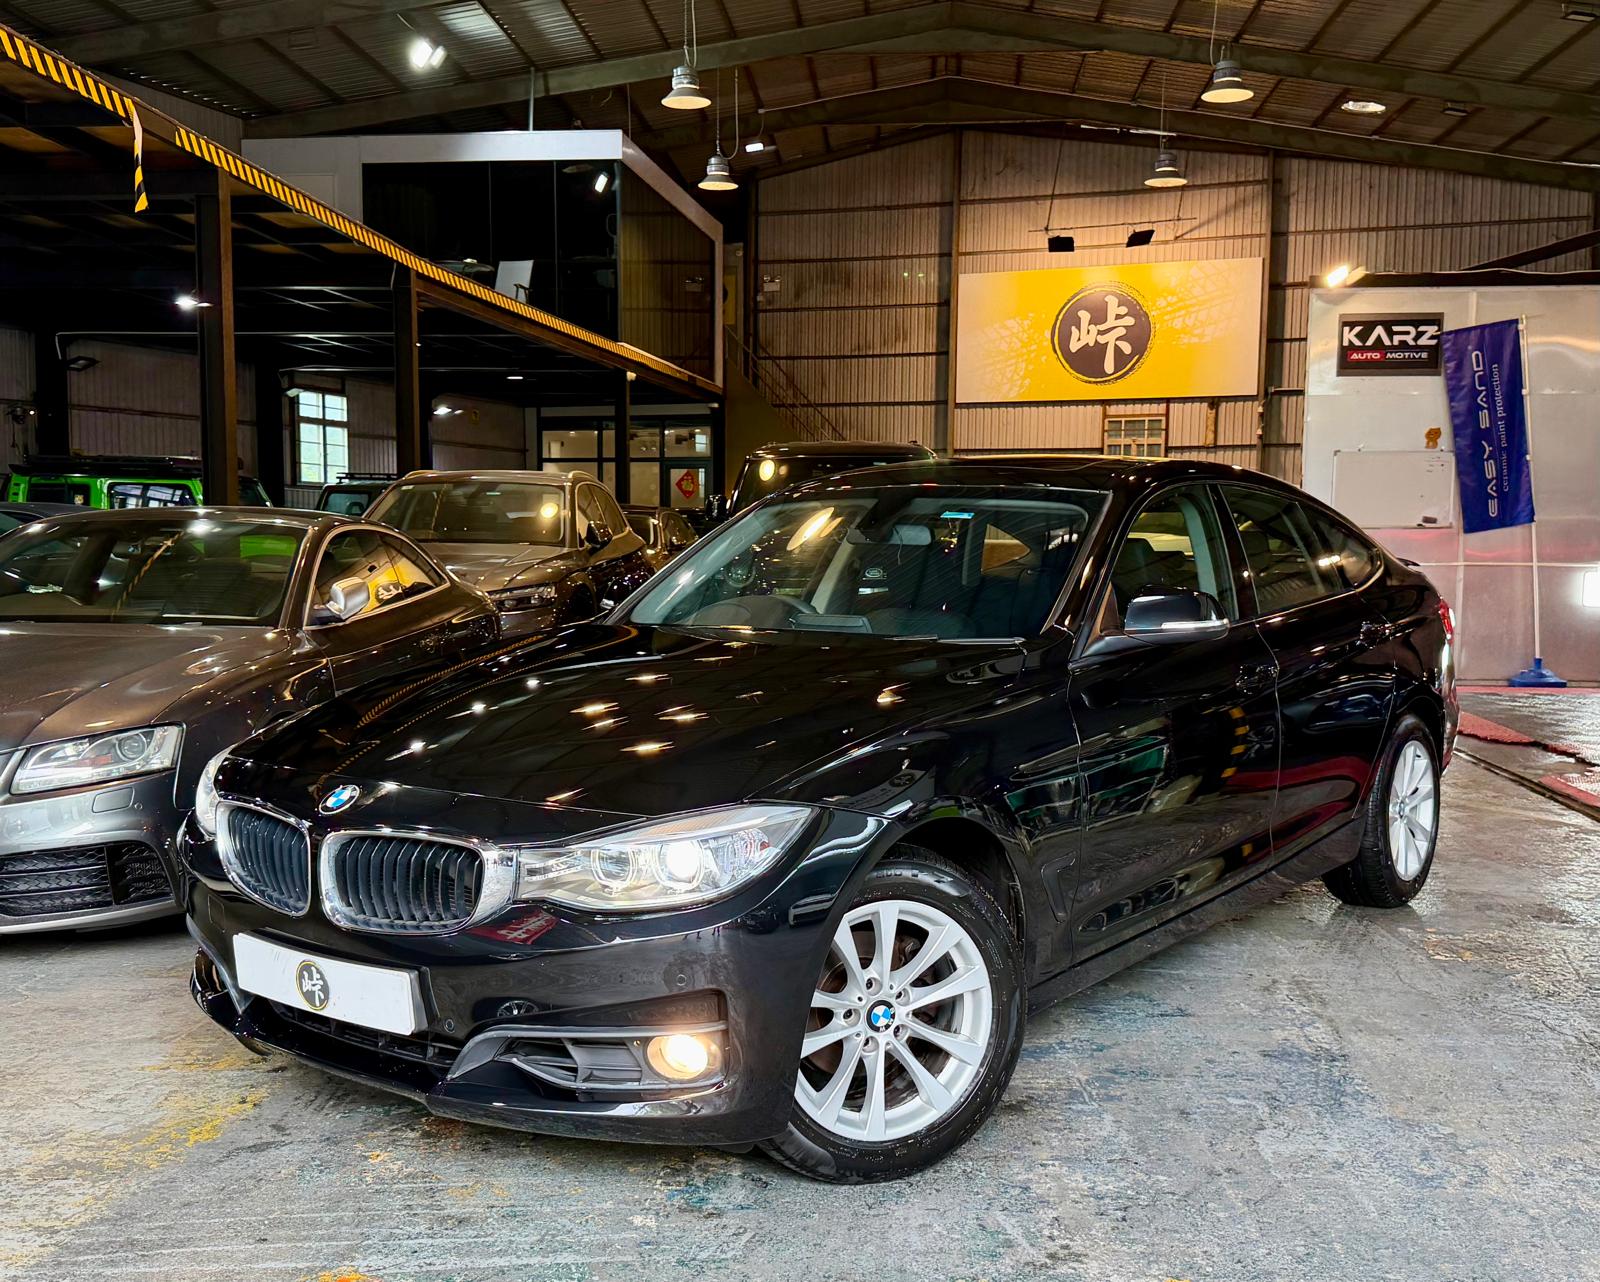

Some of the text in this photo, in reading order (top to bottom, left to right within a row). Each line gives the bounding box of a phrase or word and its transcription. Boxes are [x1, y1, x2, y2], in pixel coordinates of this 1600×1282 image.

[1069, 294, 1135, 374] 峠
[1342, 325, 1439, 346] KARZ
[1350, 351, 1428, 360] AUTO MOTIVE
[1471, 350, 1498, 517] EASY SAND
[1491, 363, 1509, 492] ceramic paint protection
[302, 966, 324, 1007] 峠
